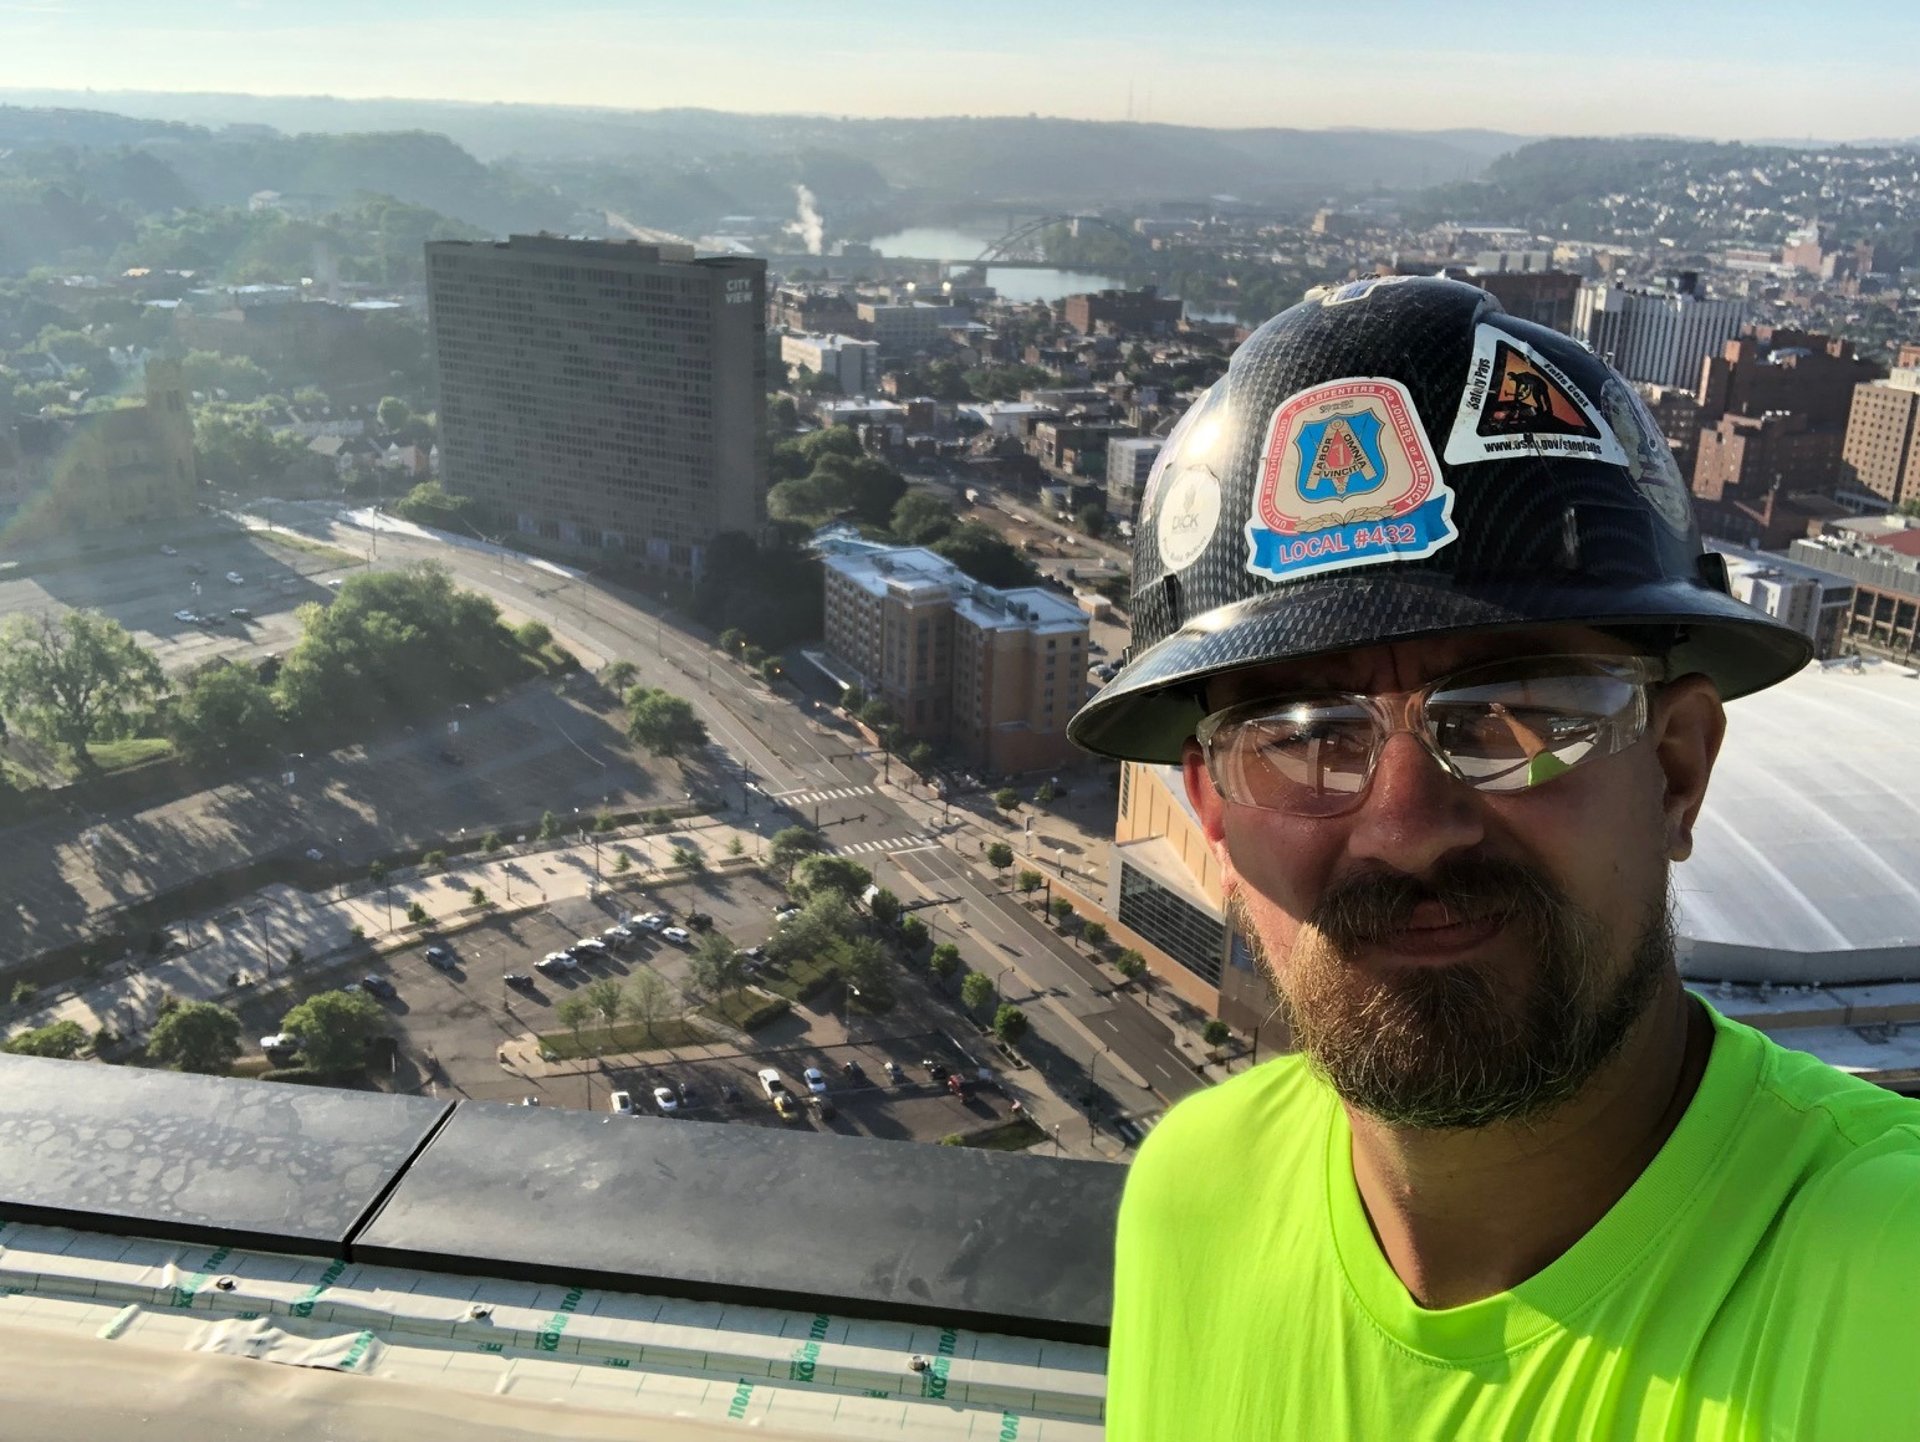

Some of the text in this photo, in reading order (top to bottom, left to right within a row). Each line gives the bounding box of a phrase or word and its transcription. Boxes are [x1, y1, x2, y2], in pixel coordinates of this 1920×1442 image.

[725, 291, 753, 304] VIEW
[726, 279, 751, 291] CITY
[1477, 358, 1491, 379] Pays
[1301, 386, 1375, 406] CARPENTERS
[1380, 389, 1395, 401] AND
[1544, 363, 1589, 408] Falls Cost
[1391, 403, 1414, 442] JOINERS
[1265, 418, 1288, 495] BROTHERHOOD
[1313, 438, 1333, 476] LABOR
[1343, 433, 1367, 469] OMNIA
[1409, 446, 1419, 456] OF
[1323, 464, 1359, 477] VINCIT
[1405, 460, 1429, 506] AMERICA
[1172, 513, 1200, 530] DICK
[1262, 500, 1288, 529] UNITED
[1279, 523, 1416, 564] LOCAL #432
